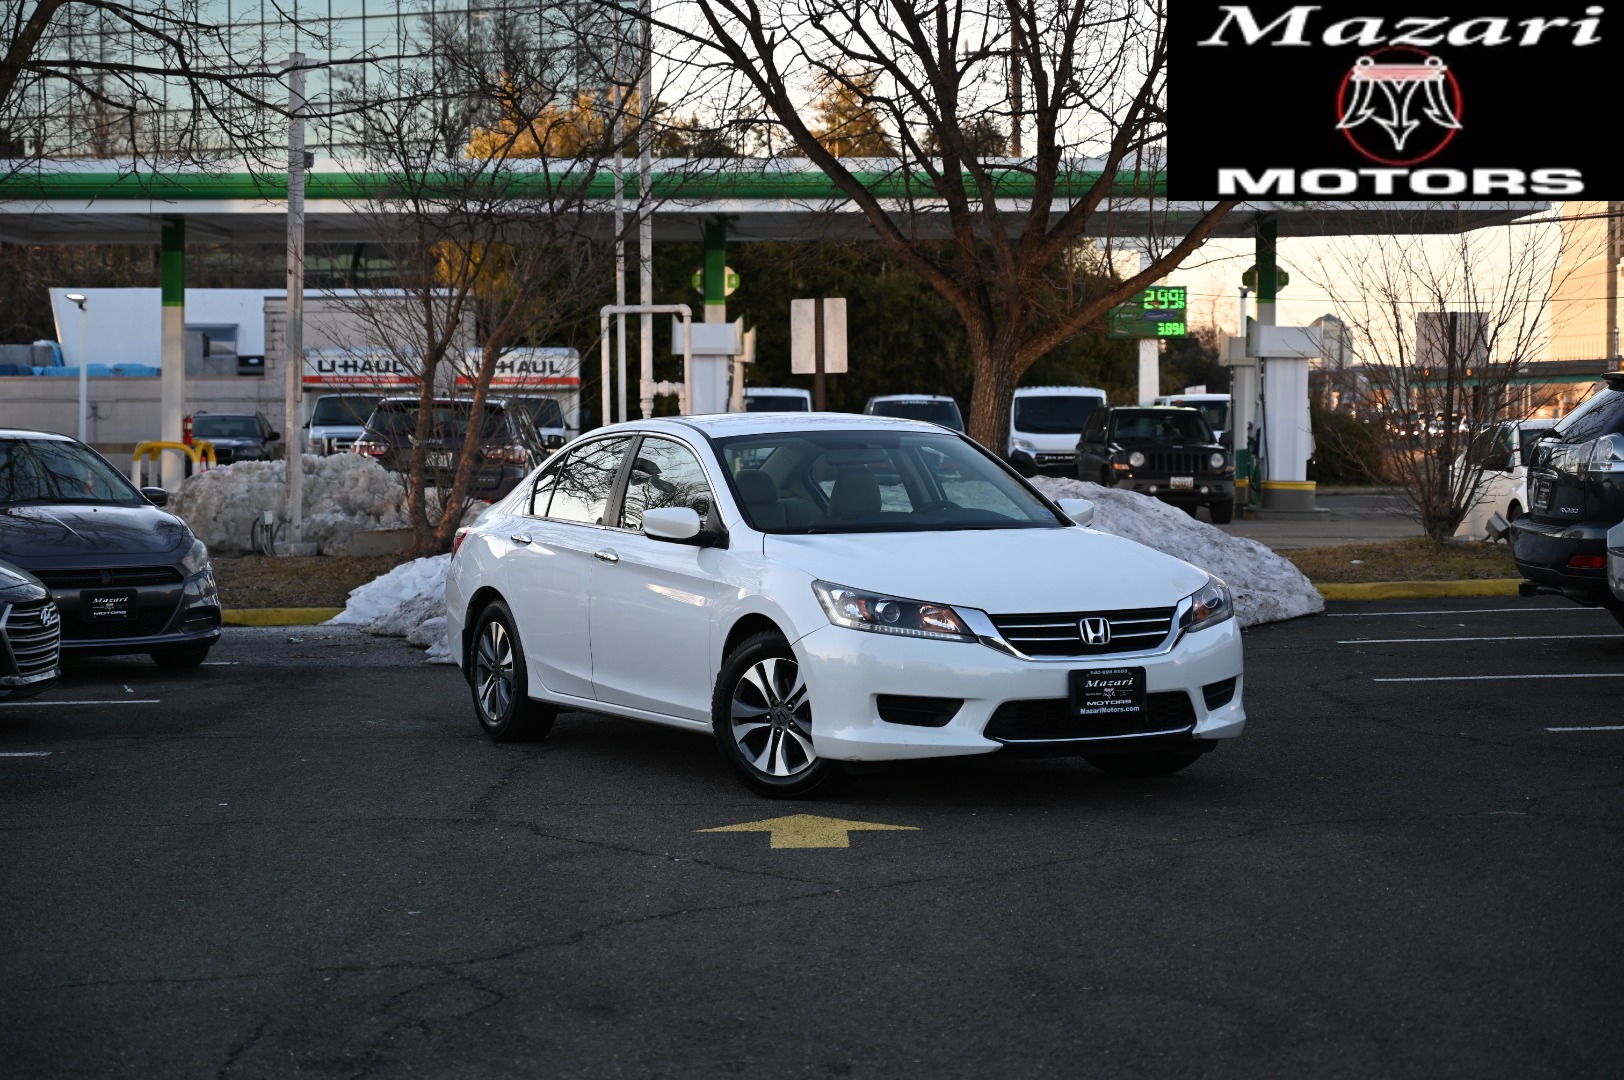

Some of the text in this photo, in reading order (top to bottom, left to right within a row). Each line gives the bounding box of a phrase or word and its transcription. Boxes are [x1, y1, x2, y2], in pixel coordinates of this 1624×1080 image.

[1084, 677, 1134, 688] Mazari
[1086, 699, 1132, 707] MOTORS
[1080, 706, 1140, 715] MazariMotors.com
